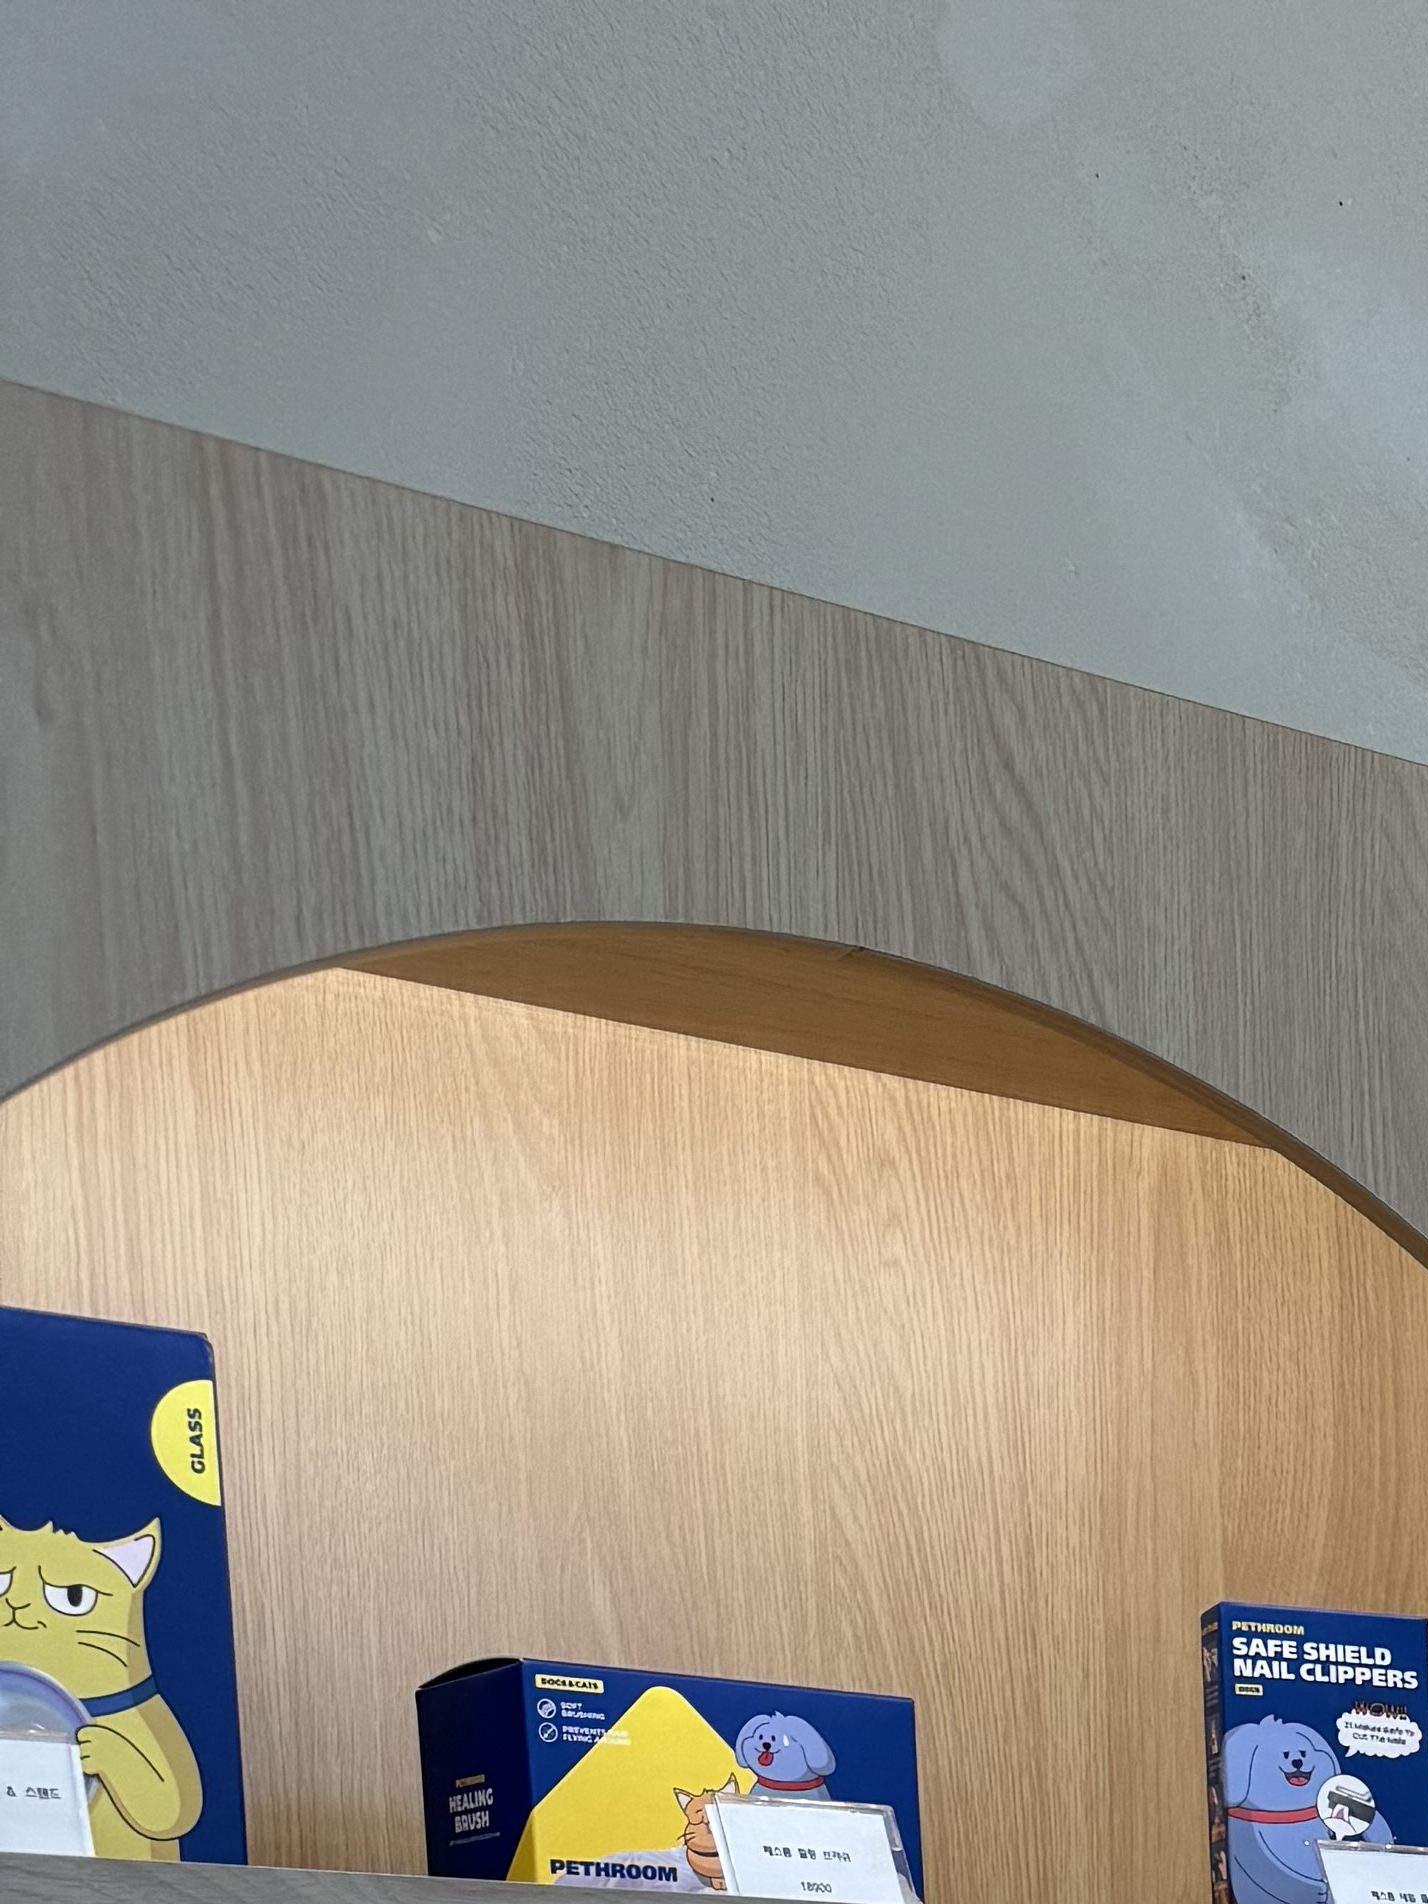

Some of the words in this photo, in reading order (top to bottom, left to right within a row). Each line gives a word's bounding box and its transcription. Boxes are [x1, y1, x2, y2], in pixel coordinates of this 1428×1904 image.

[187, 1408, 205, 1474] GLASS
[1232, 1620, 1305, 1636] PETHROOM
[1232, 1637, 1298, 1659] SAFE
[1303, 1642, 1392, 1666] SHIELD
[1233, 1658, 1296, 1680] NAIL
[1299, 1663, 1419, 1690] CLIPPERS
[449, 1788, 494, 1813] HEALING
[549, 1858, 678, 1882] PETHROOM
